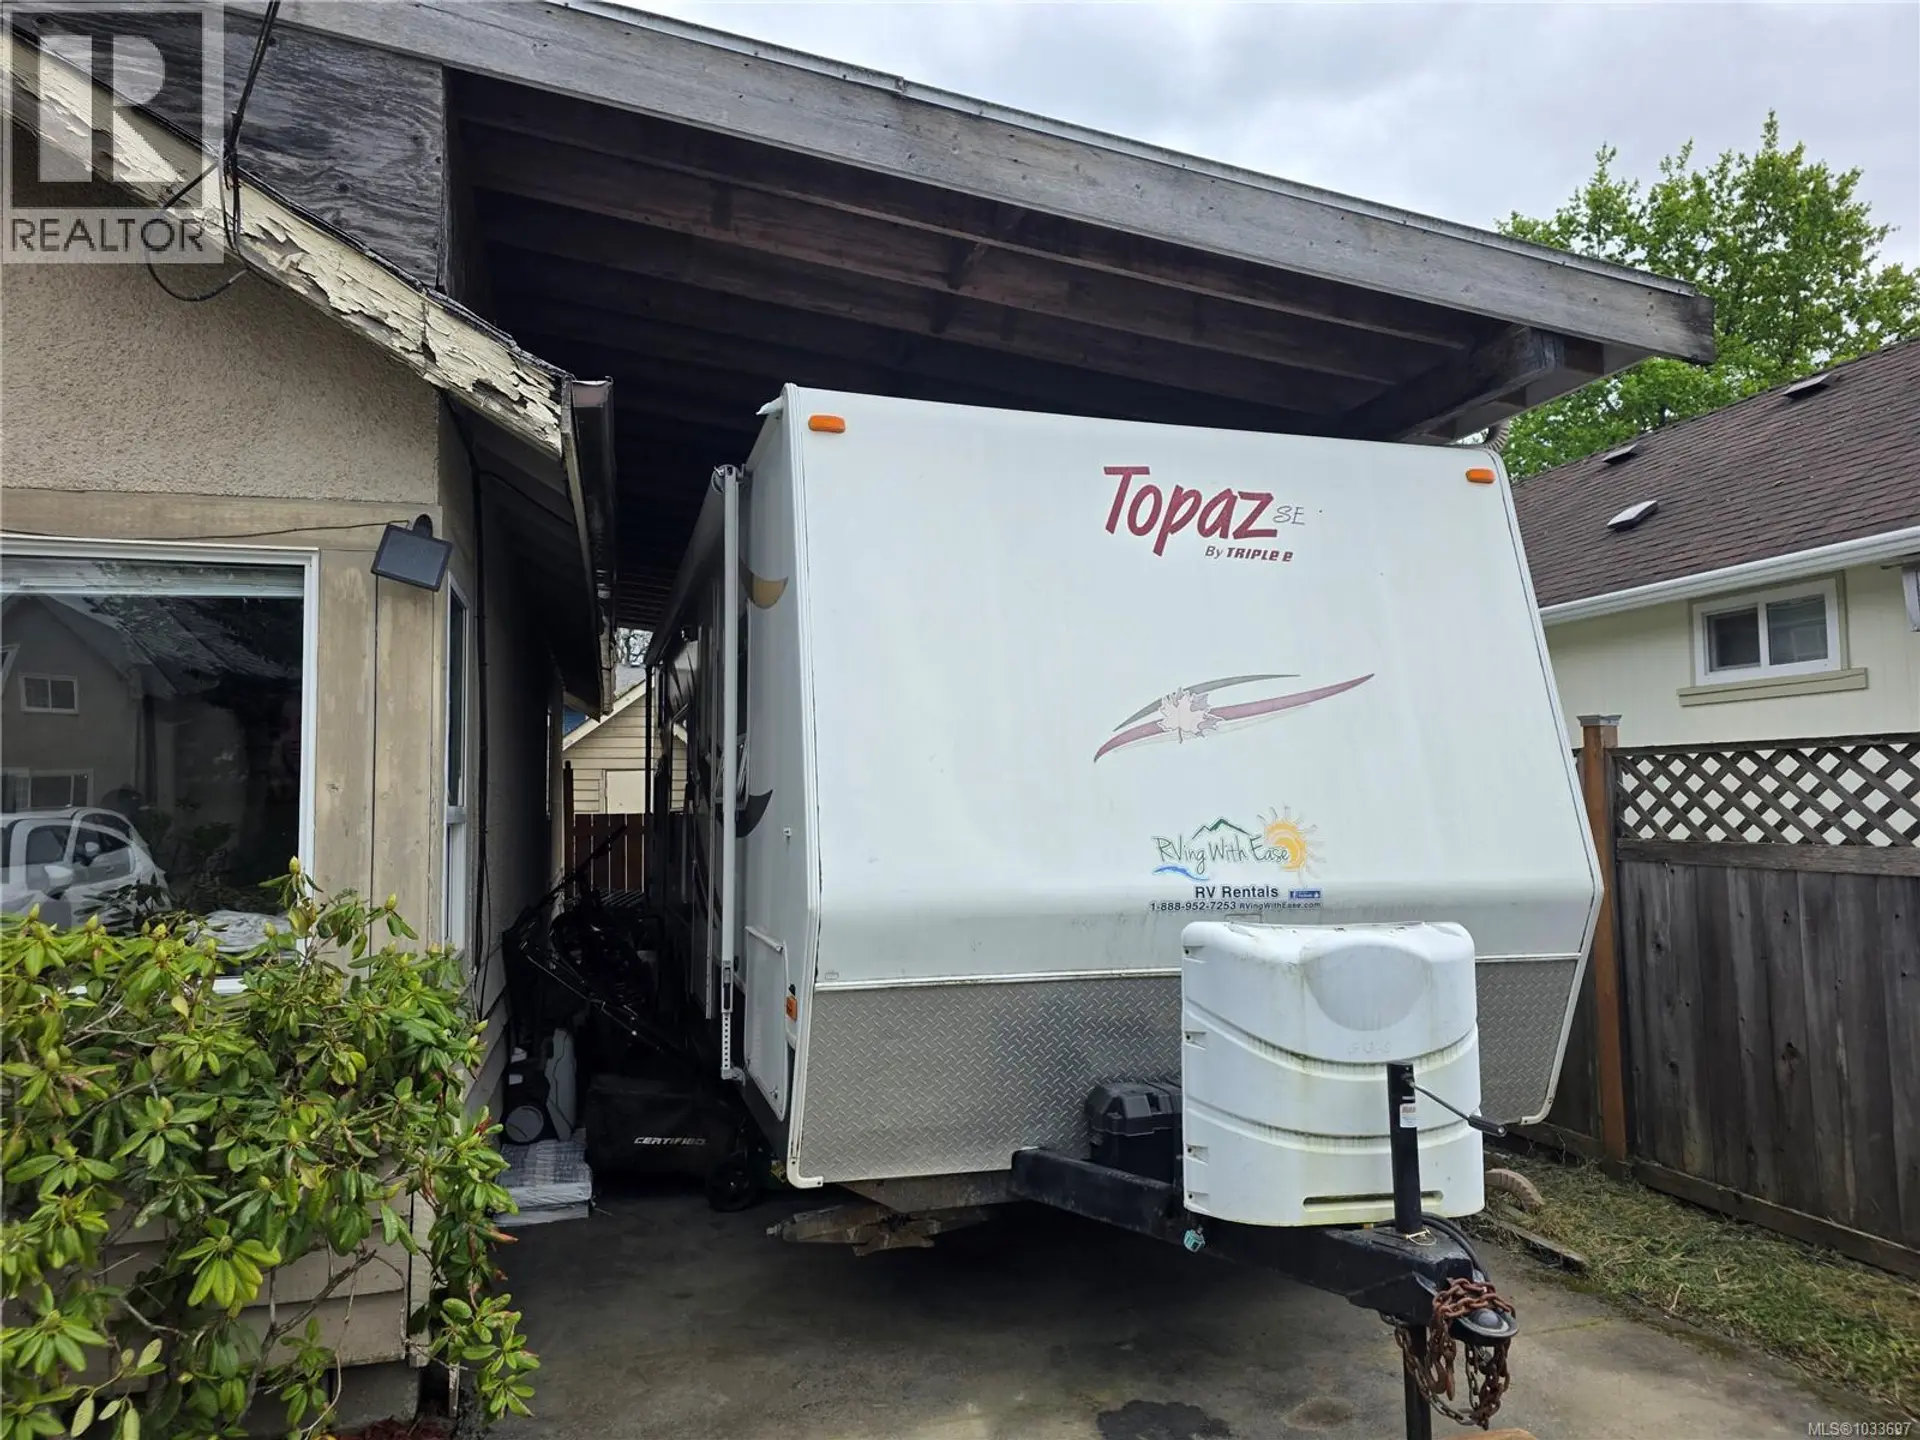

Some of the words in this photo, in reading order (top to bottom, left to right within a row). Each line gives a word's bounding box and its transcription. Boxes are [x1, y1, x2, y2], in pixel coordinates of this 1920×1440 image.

[1103, 465, 1278, 558] Topaz
[1272, 505, 1307, 526] SE
[1204, 545, 1224, 560] By
[1151, 835, 1207, 875] RVing
[1208, 836, 1248, 862] With
[1249, 834, 1290, 863] Ease
[1195, 886, 1216, 899] RV
[1222, 885, 1279, 899] Rentals
[1150, 901, 1237, 912] 1-888-952-7253
[633, 1136, 707, 1146] CERTIFIED
